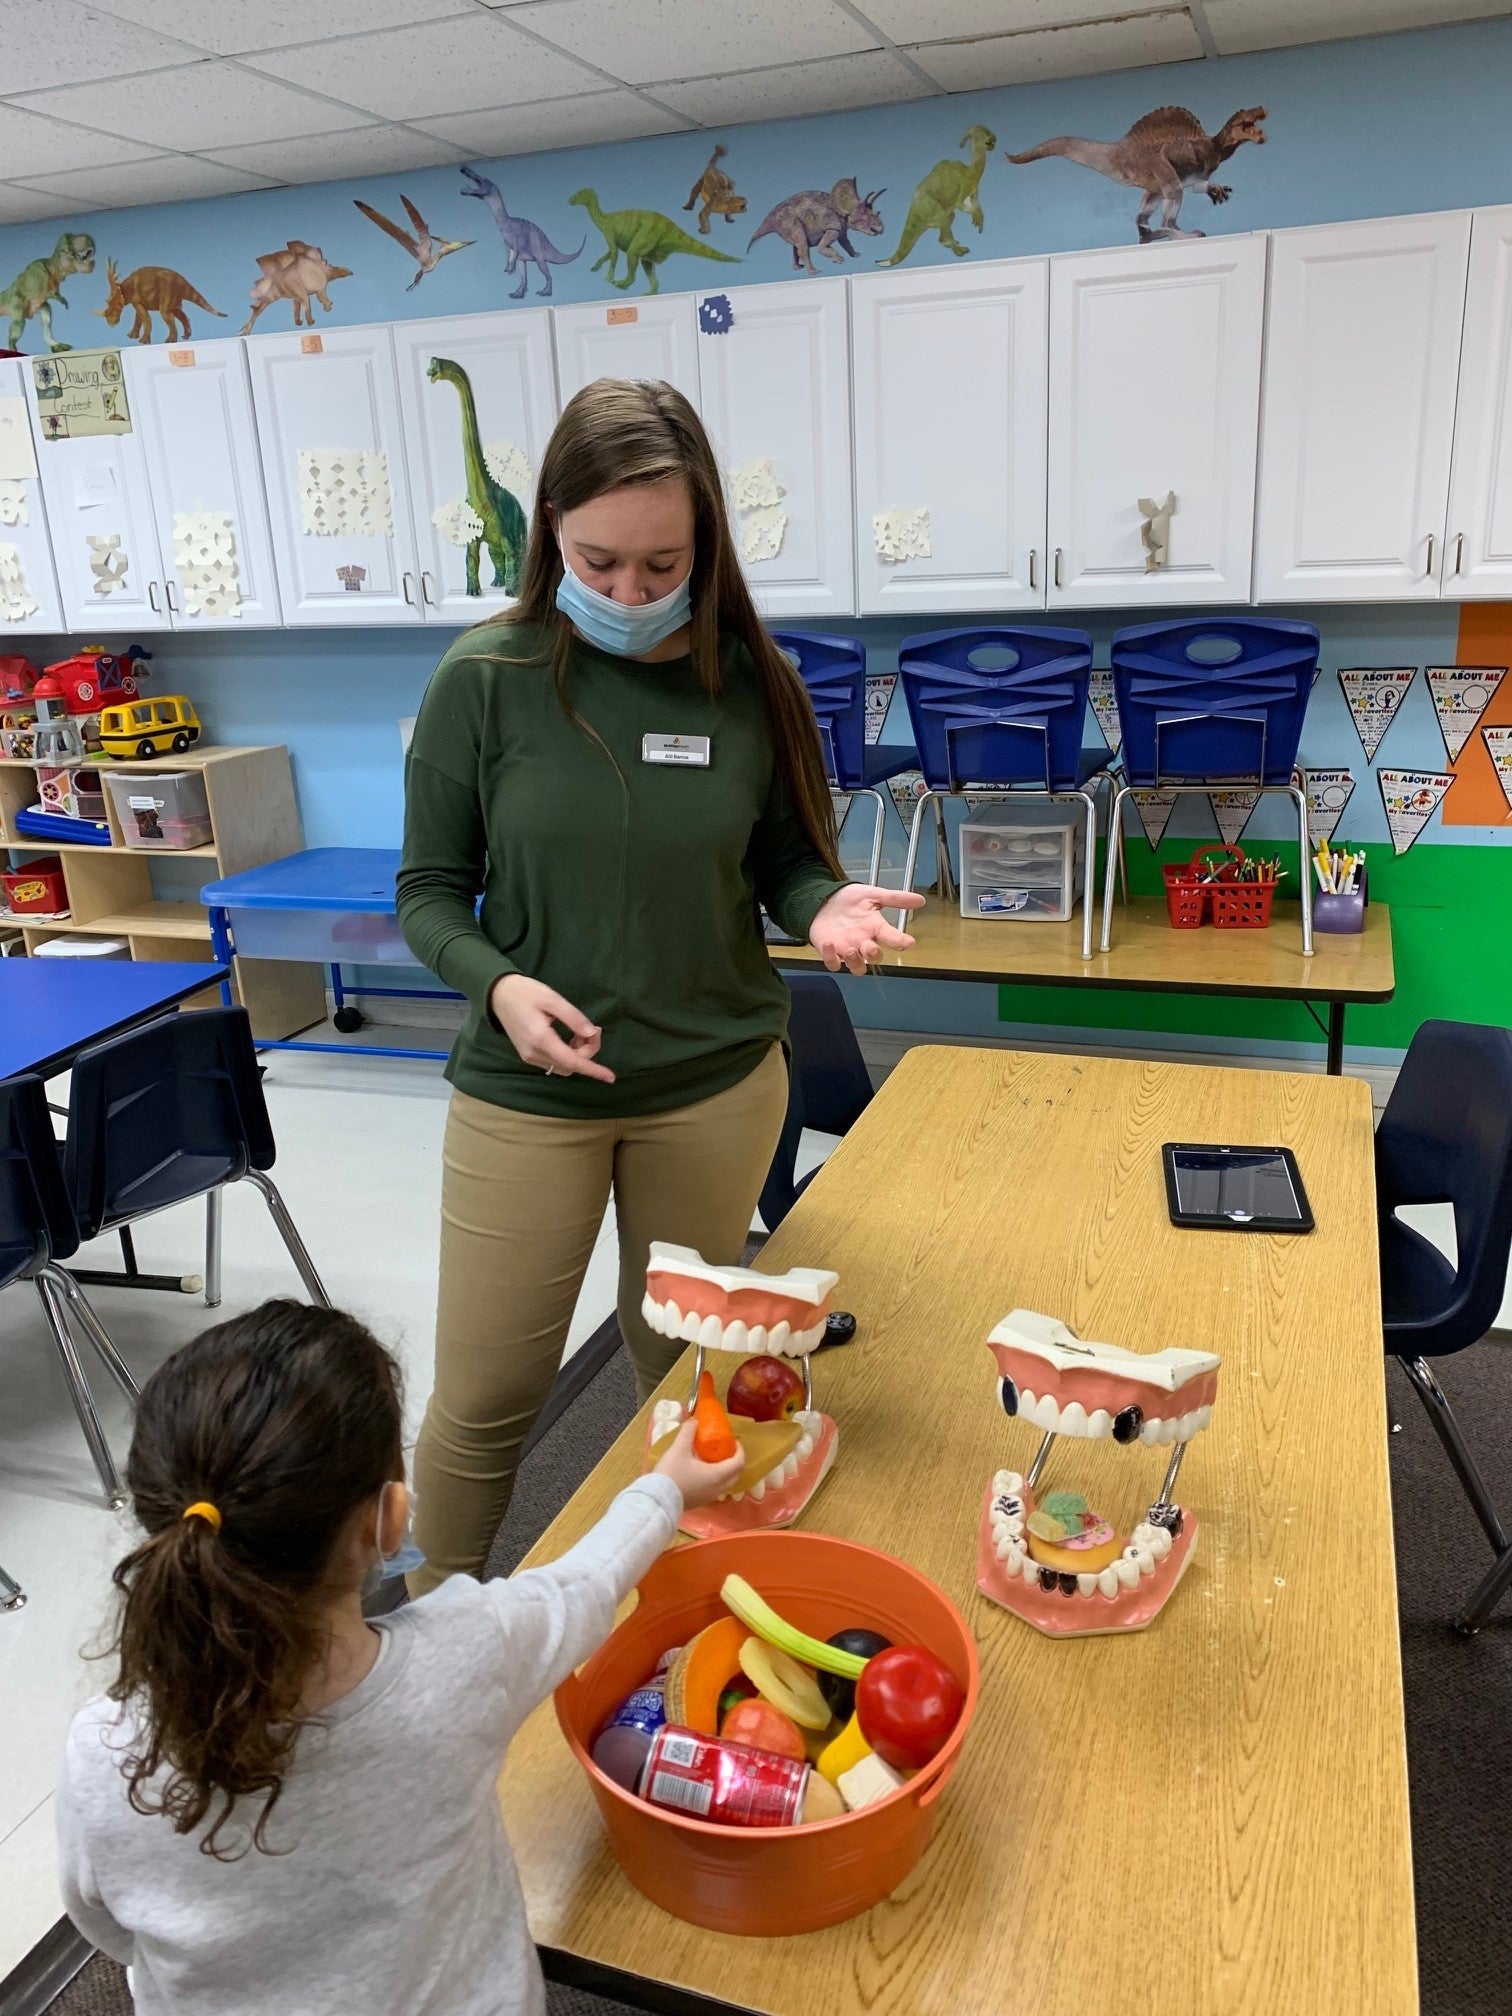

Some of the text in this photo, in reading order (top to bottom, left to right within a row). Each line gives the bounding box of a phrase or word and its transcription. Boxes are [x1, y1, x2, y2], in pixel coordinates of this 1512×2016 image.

[55, 358, 99, 390] Drawing
[54, 394, 92, 413] Contest
[1362, 673, 1395, 681] ABOUT
[1396, 673, 1411, 681] ME
[1430, 672, 1500, 682] ALL ABOUT ME
[1487, 731, 1505, 740] ALL
[1309, 774, 1340, 782] ABOUT
[1382, 773, 1449, 787] ALL ABOUT ME
